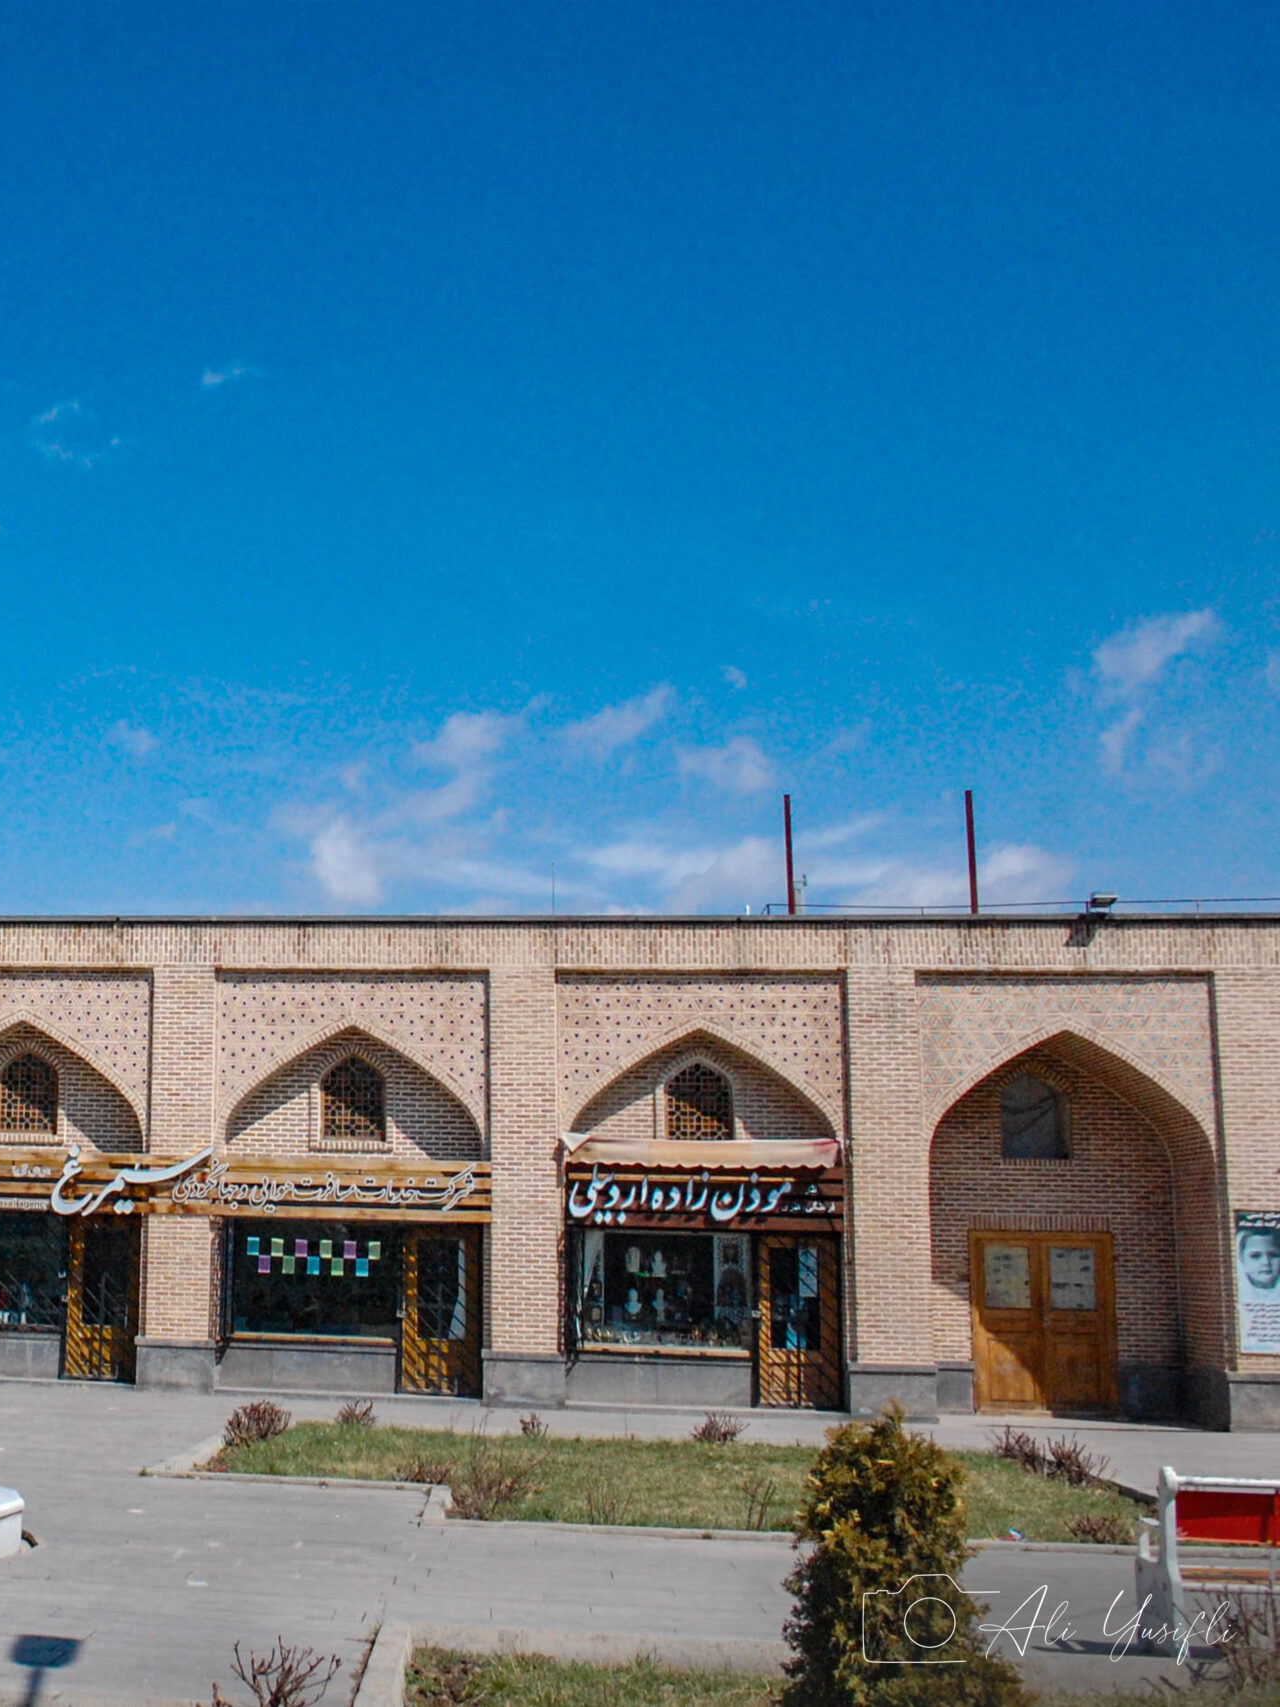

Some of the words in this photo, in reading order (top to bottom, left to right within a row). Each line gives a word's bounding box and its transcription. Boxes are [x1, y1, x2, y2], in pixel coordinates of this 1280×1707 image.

[51, 1145, 214, 1216] سیمرغ
[249, 1174, 294, 1213] هوایی
[292, 1171, 357, 1202] مسافرت
[356, 1177, 418, 1203] خدمات
[415, 1162, 477, 1211] شرکت
[569, 1163, 650, 1225] اردبیلی
[652, 1171, 709, 1211] زاده
[18, 1199, 50, 1211] agency
